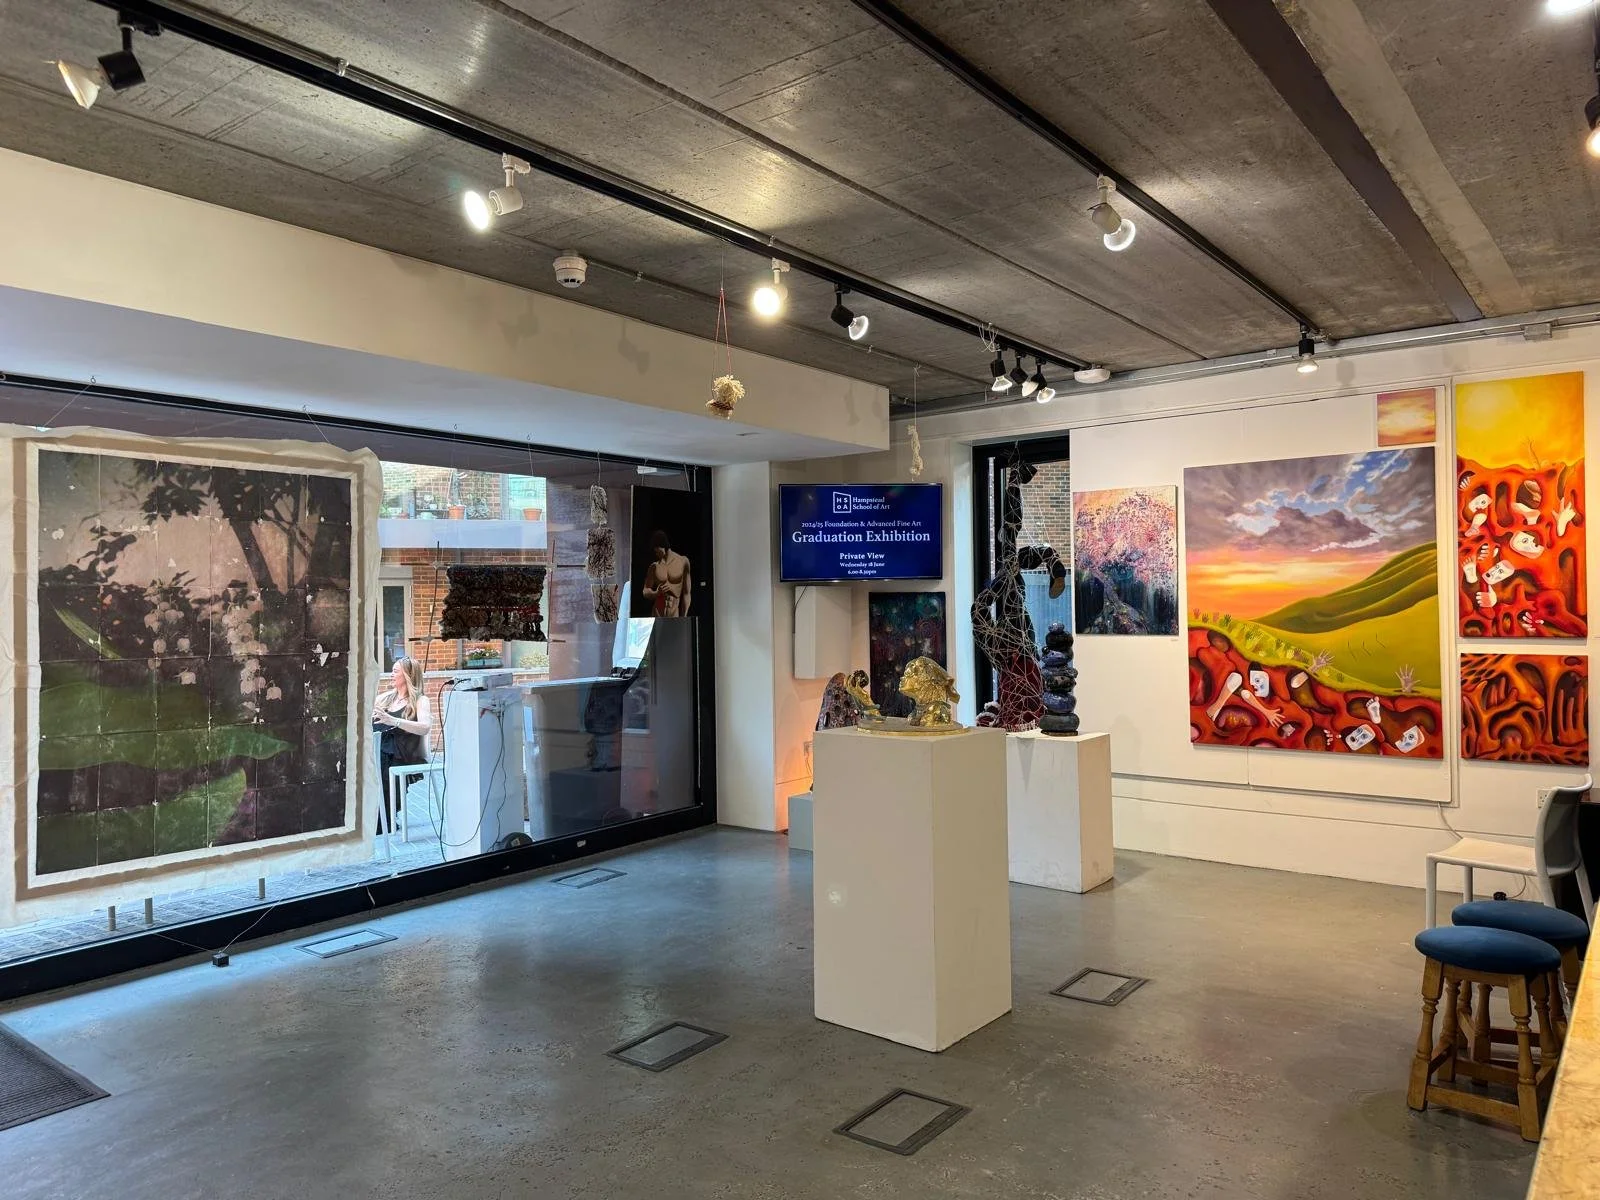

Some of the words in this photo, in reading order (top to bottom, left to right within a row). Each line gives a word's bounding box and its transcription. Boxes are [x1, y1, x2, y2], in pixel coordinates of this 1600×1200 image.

[852, 496, 885, 504] Hampstead
[792, 530, 863, 543] Graduation
[866, 530, 930, 541] Exhibition
[839, 552, 865, 560] Private
